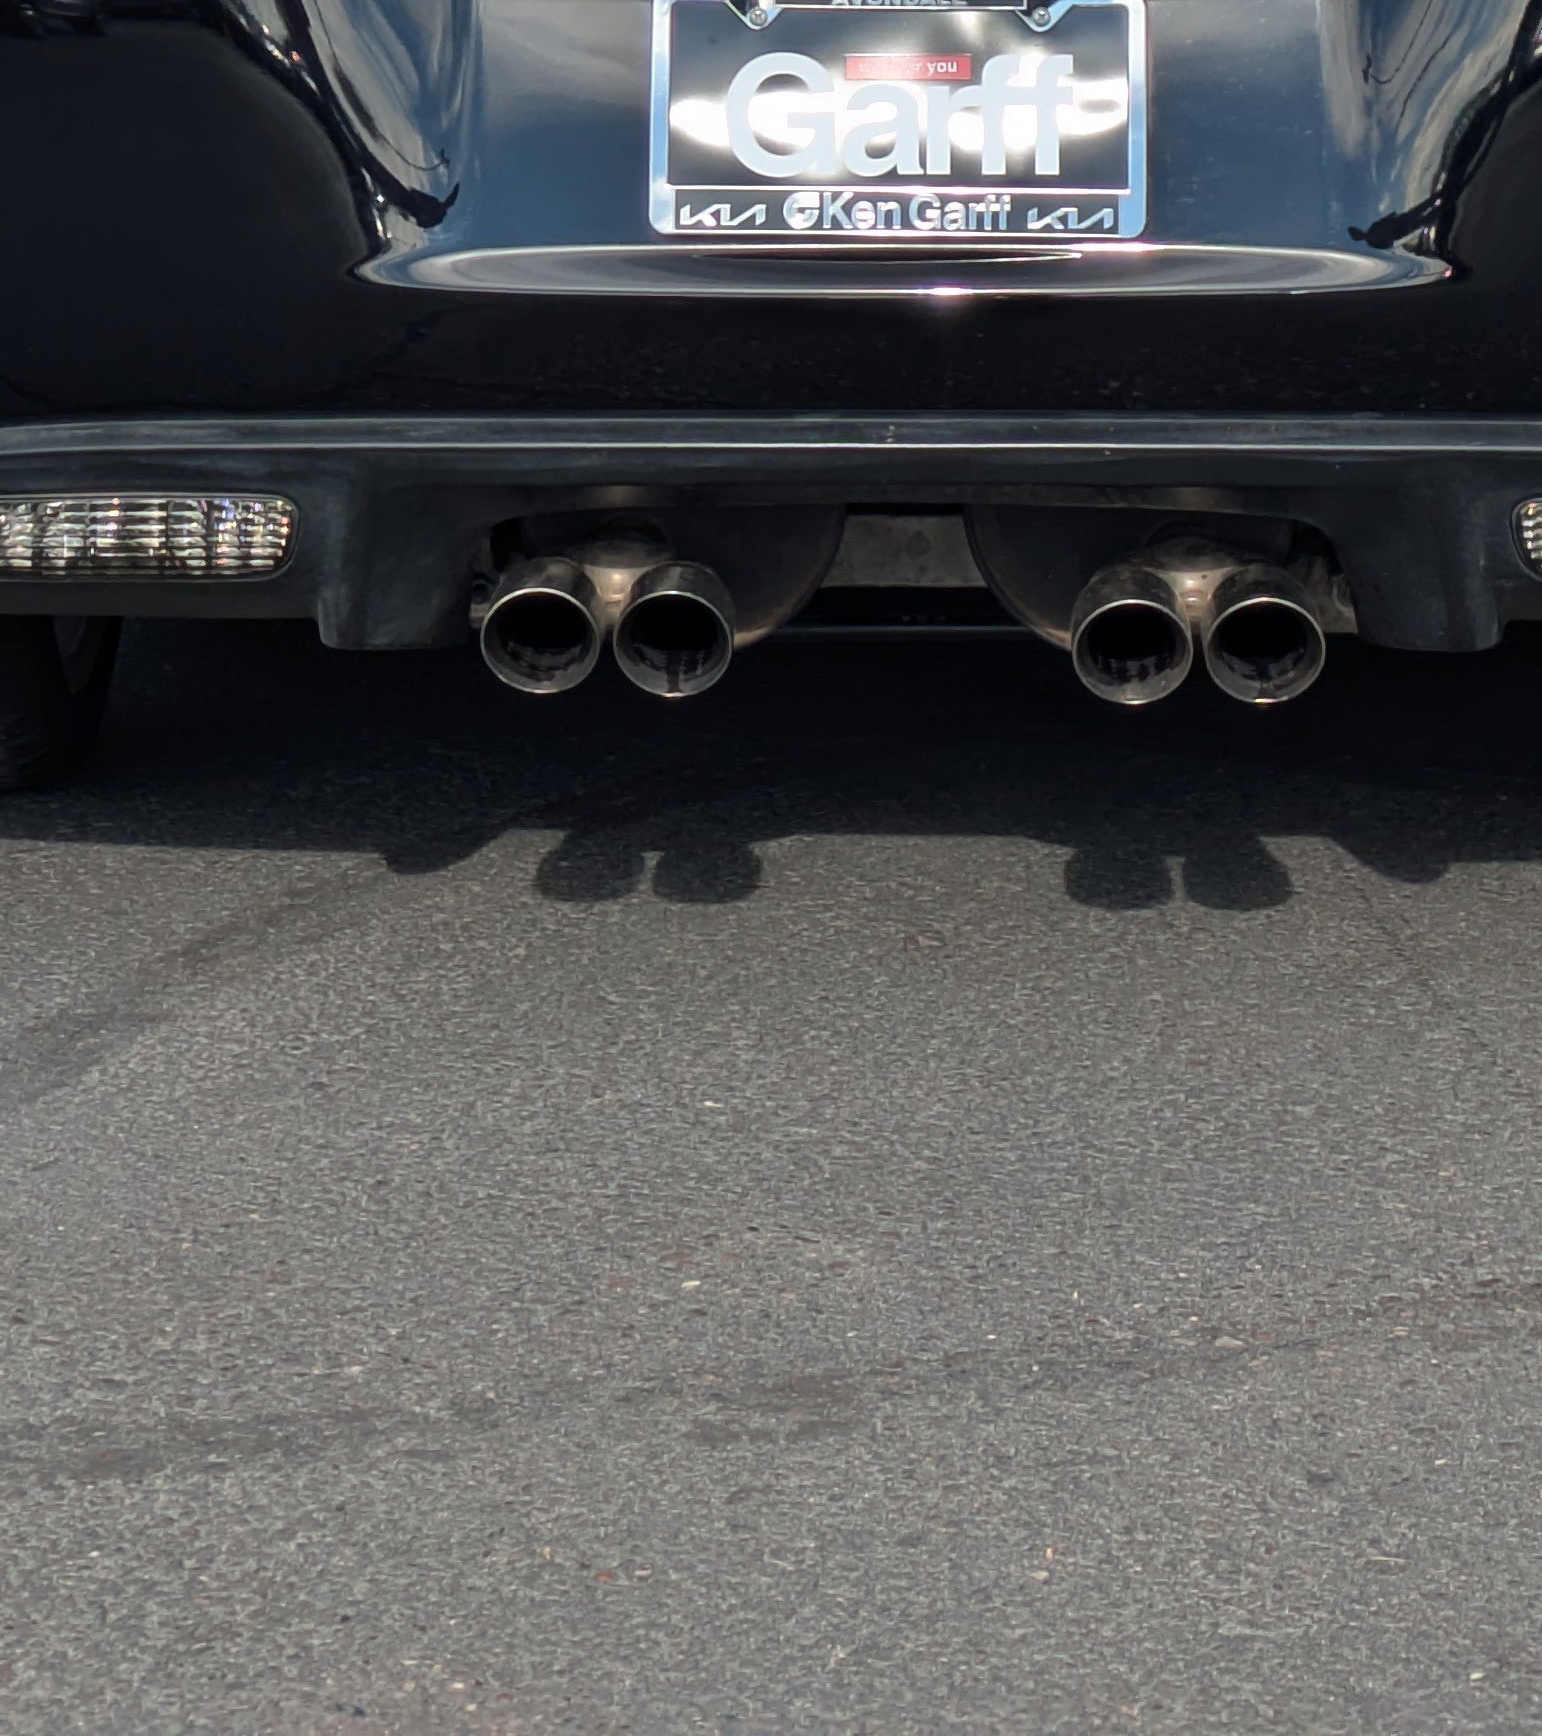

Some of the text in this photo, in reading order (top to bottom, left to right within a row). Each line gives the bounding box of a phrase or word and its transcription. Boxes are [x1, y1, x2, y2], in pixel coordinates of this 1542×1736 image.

[926, 60, 958, 76] you
[725, 51, 1074, 178] Garff
[678, 191, 1115, 231] KIA Ken Garff KIA
